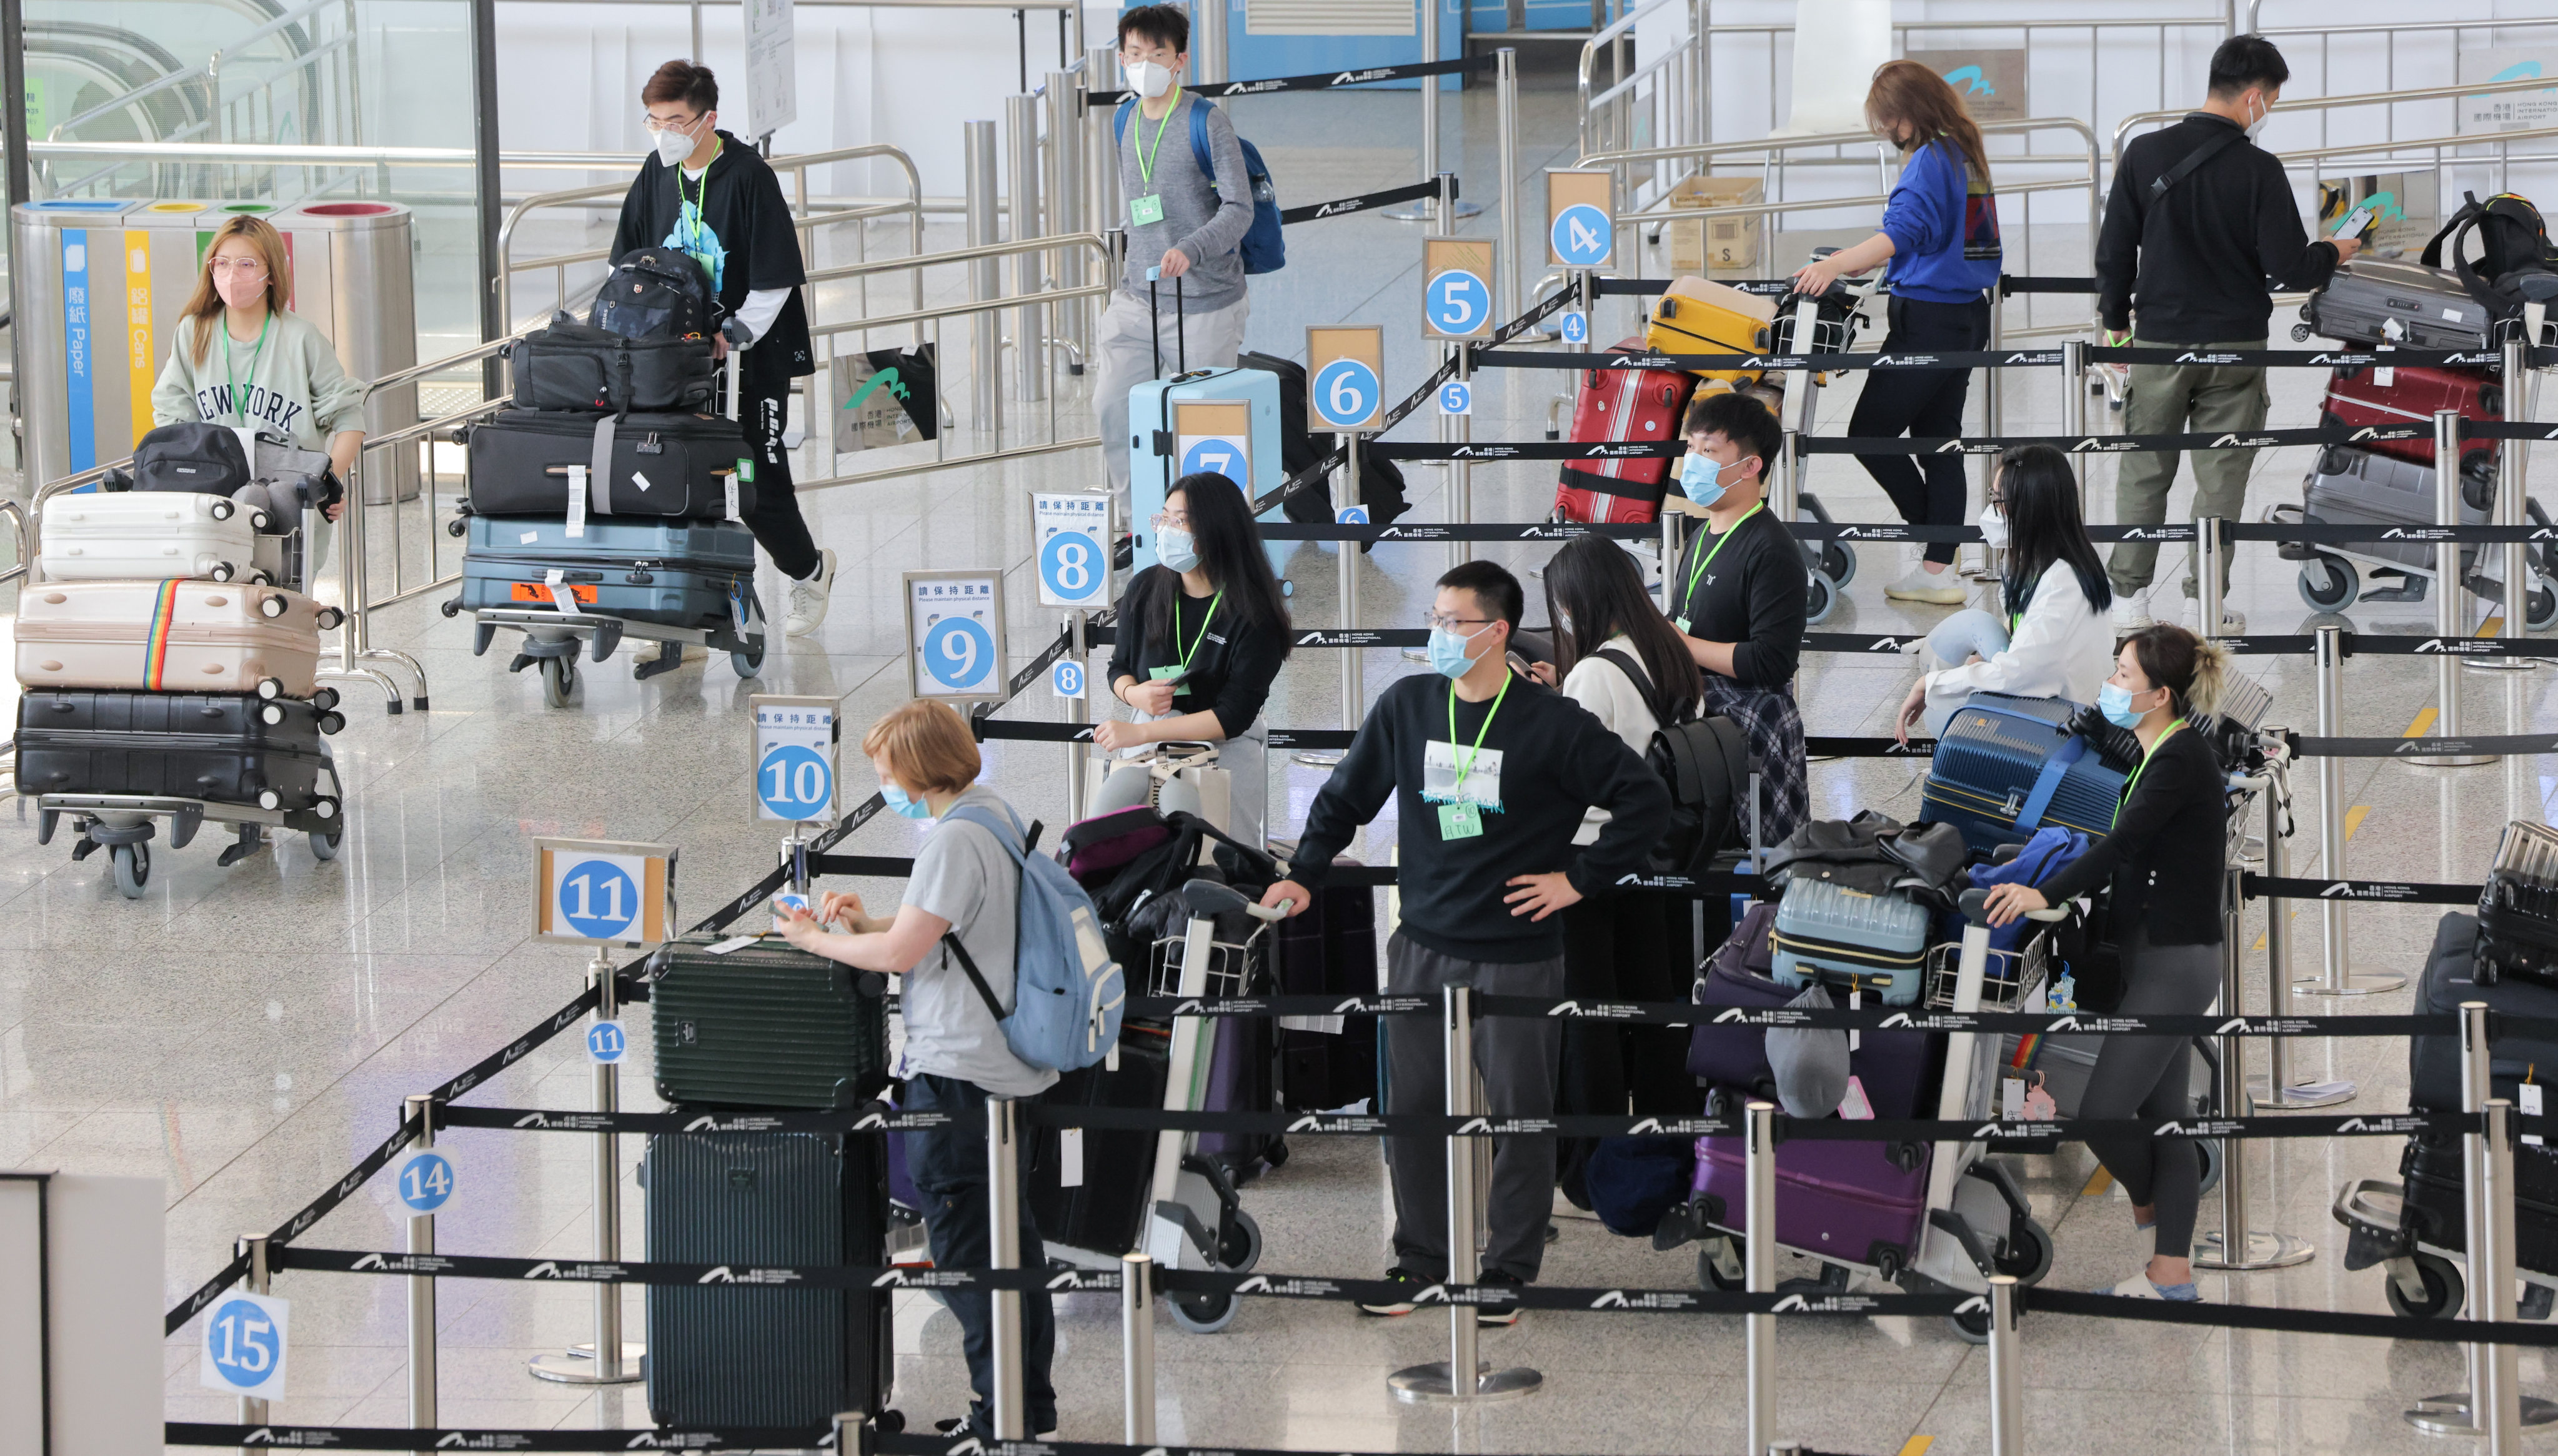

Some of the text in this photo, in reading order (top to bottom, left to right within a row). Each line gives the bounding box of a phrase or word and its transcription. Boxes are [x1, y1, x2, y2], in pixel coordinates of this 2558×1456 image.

[2494, 104, 2511, 112] 香港
[1569, 216, 1601, 253] 4
[1723, 248, 1730, 262] S
[69, 287, 86, 324] 廢紙
[1444, 280, 1471, 324] 5
[1567, 317, 1580, 336] 4
[71, 328, 85, 377] Paper
[134, 329, 147, 369] Cans
[197, 384, 302, 432] EW YORK
[1330, 370, 1362, 415] 6
[1449, 388, 1462, 407] 5
[1199, 453, 1231, 475] 7
[1039, 500, 1104, 511] 請保持距離
[1057, 543, 1089, 589] 8
[918, 585, 989, 596] 請保持距離
[942, 630, 977, 679] 9
[1062, 668, 1077, 690] 8
[757, 713, 831, 725] 請保持距離
[765, 760, 825, 804] 10
[569, 874, 629, 921] 11
[591, 1029, 622, 1052] 11
[404, 1162, 450, 1201] 14
[217, 1315, 271, 1372] 15
